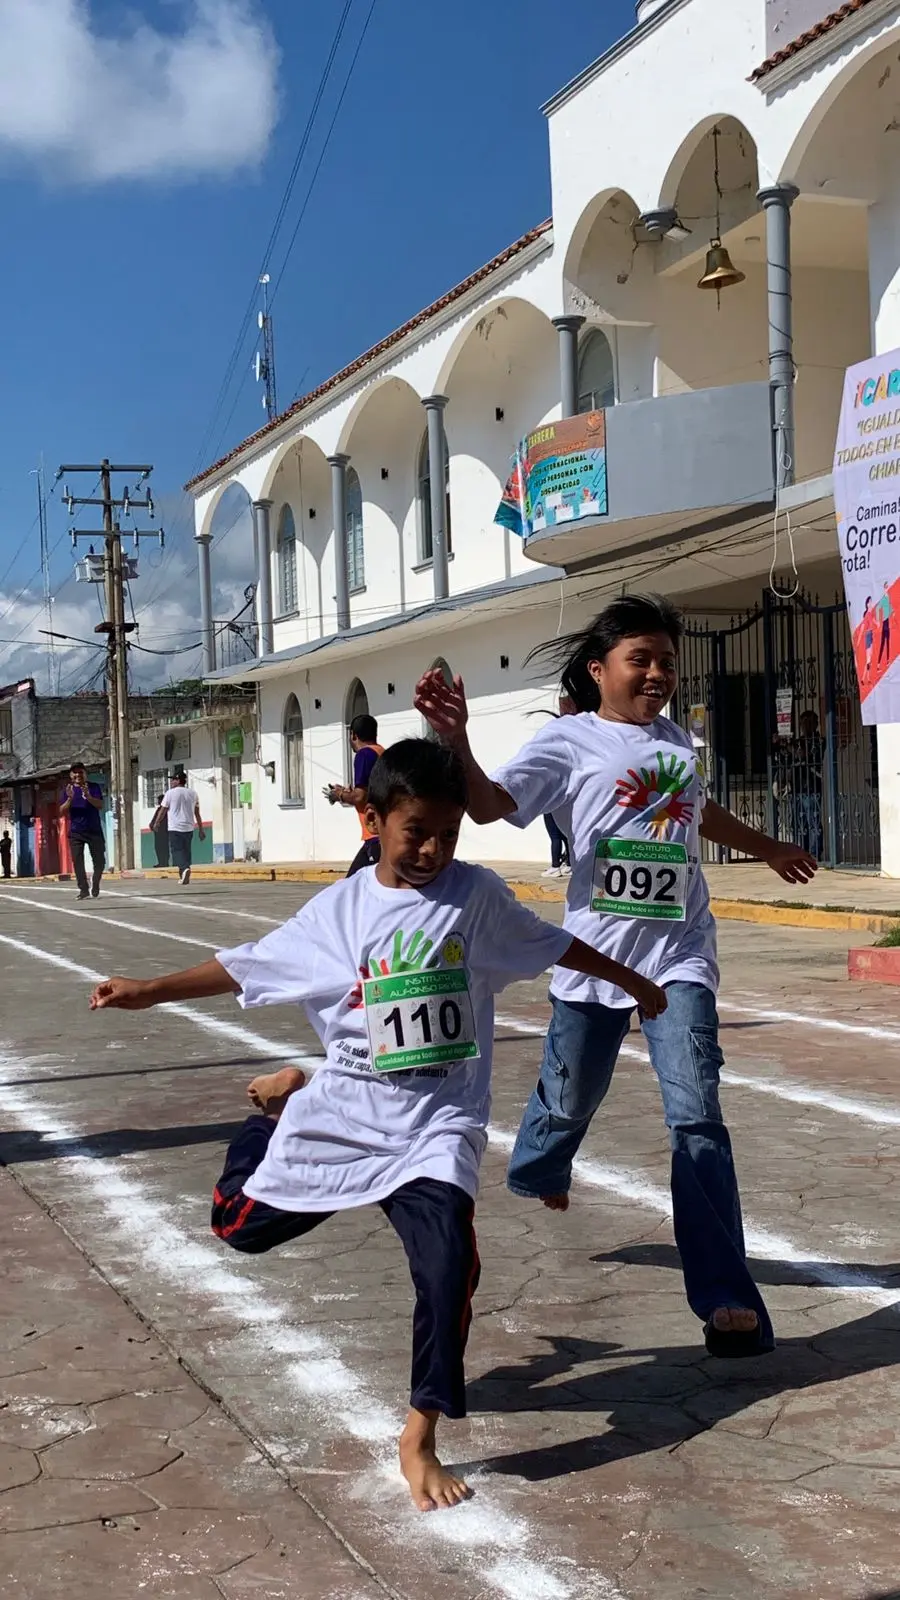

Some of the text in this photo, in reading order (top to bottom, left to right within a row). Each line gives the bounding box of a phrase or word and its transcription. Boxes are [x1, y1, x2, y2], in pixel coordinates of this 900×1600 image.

[547, 469, 578, 482] PERSONAS
[579, 464, 594, 473] CON
[541, 479, 580, 496] DISCAPACIDAD
[617, 851, 657, 860] ALFONSO
[632, 844, 671, 853] INSTITUTO
[604, 864, 677, 902] 092
[404, 974, 451, 987] INSTITUTO
[390, 984, 437, 998] ALFONSO
[384, 1000, 462, 1047] 110
[406, 1052, 421, 1063] para
